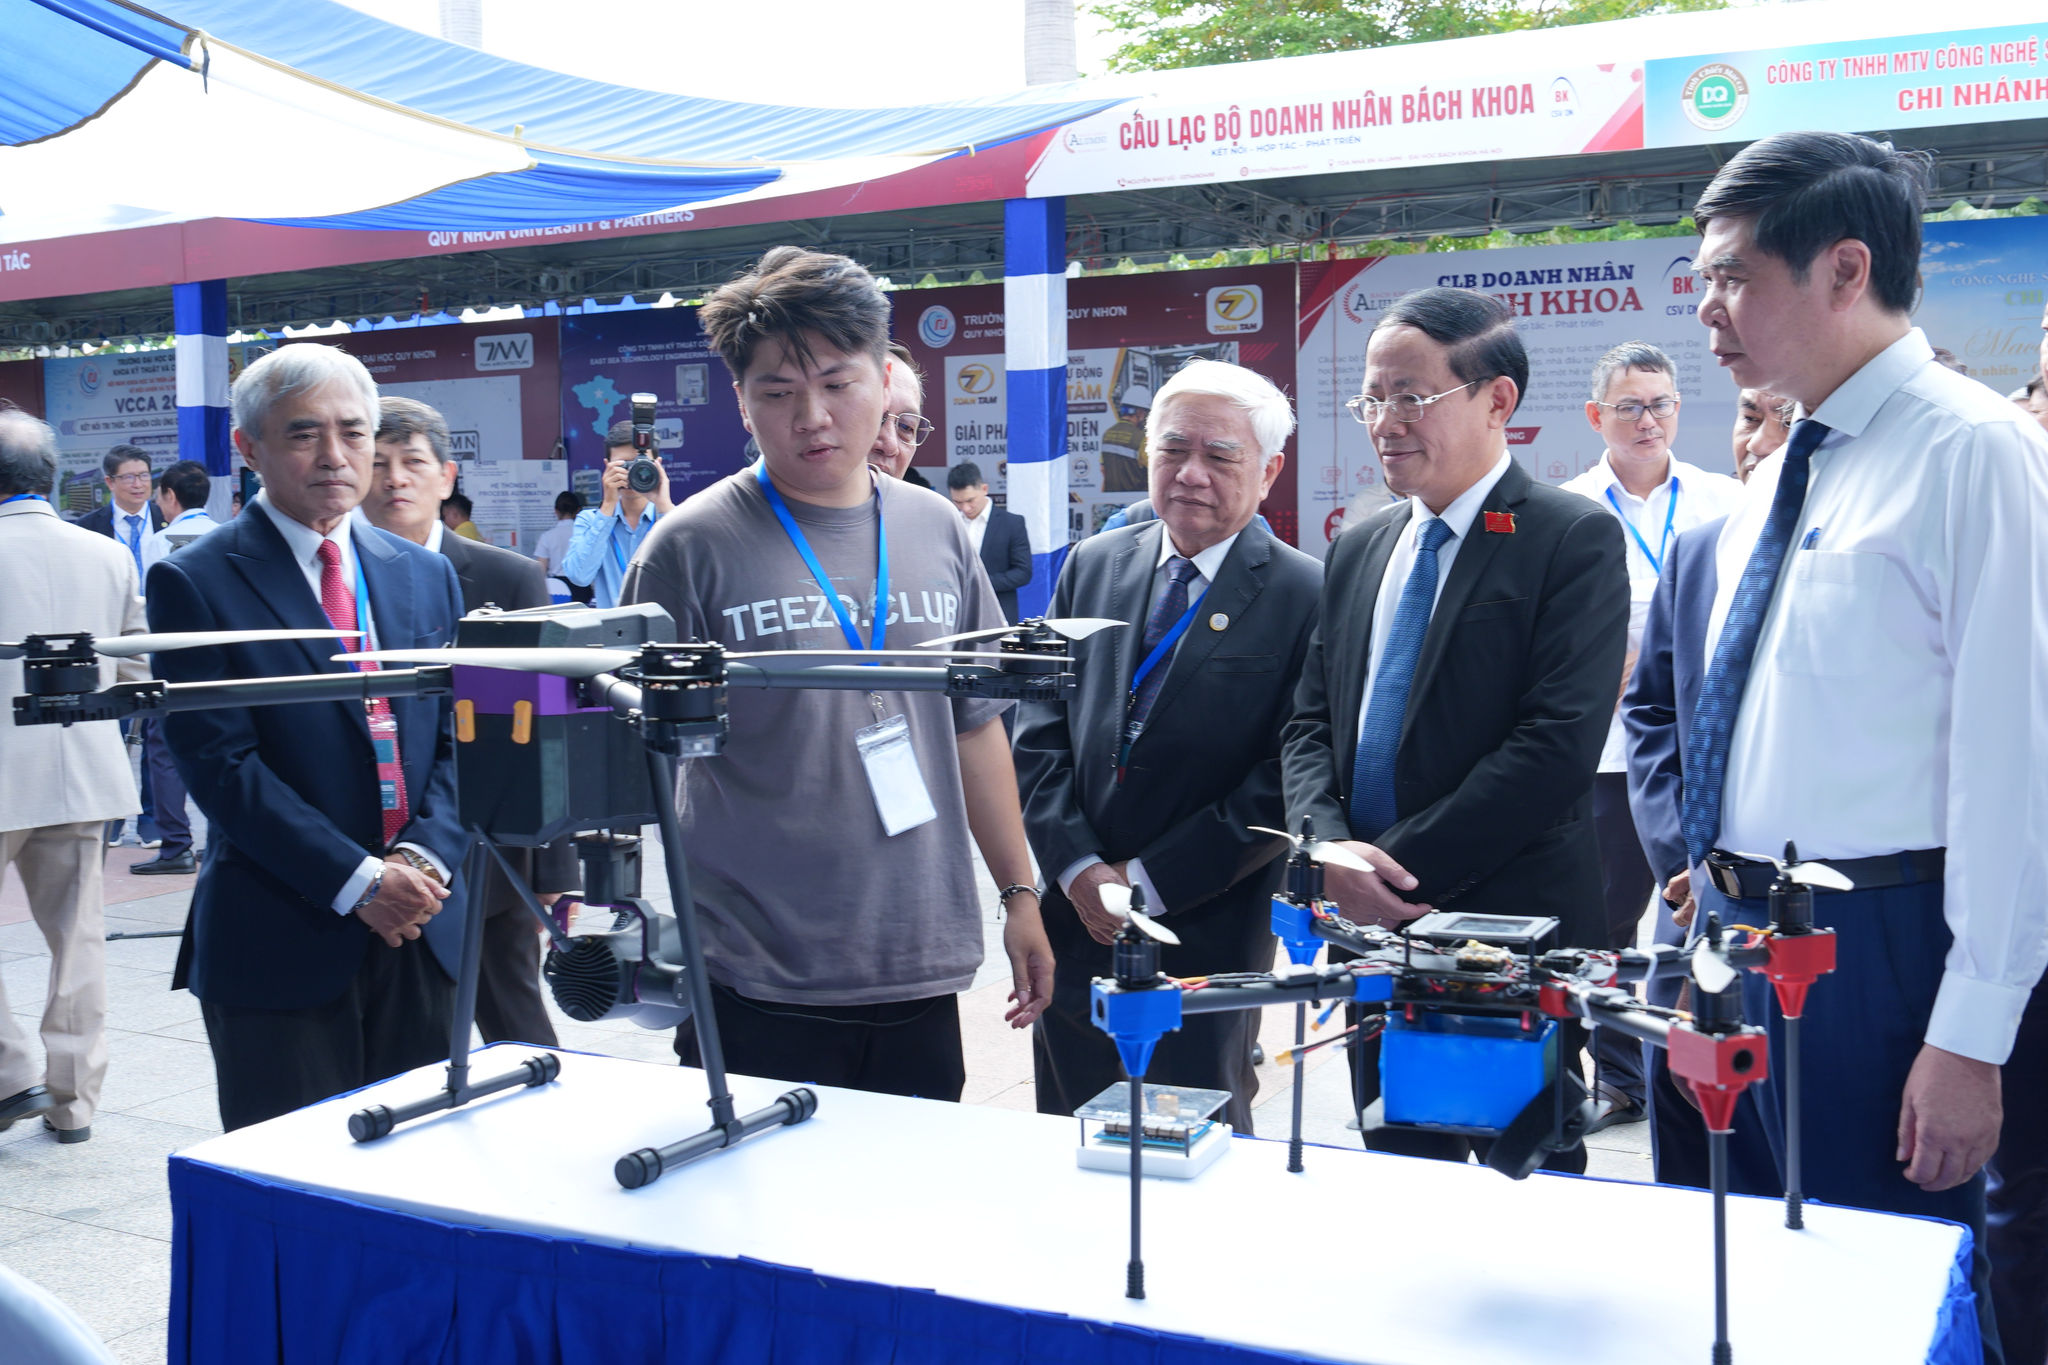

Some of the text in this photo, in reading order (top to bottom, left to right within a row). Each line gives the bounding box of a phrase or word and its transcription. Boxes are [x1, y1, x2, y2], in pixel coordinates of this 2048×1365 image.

[1767, 59, 1812, 84] CÔNG
[1818, 59, 1837, 80] TY
[1842, 55, 1887, 78] TNHH
[1893, 50, 1929, 73] MTV
[1936, 43, 1983, 69] CÔNG
[1990, 36, 2037, 66] NGHỆ
[1555, 90, 1568, 103] BK
[1898, 76, 2048, 111] CHI NHÁNH
[1168, 114, 1206, 151] LẠC
[1214, 104, 1241, 146] BỘ
[1250, 103, 1323, 138] DOANH
[1332, 89, 1392, 131] NHÂN
[1401, 85, 1462, 123] BÁCH
[1472, 83, 1535, 118] KHOA
[428, 231, 460, 247] QUY
[614, 210, 695, 229] PARTNERS
[3, 249, 31, 271] TÁC
[1437, 261, 1635, 289] CLB DOANH NHÂN
[1540, 287, 1644, 316] KHOA
[1665, 304, 1684, 316] CSV
[963, 329, 983, 339] QUY
[1075, 366, 1103, 381] ĐỘNG
[115, 395, 158, 414] VCCA
[955, 419, 982, 441] GIẢI
[1067, 416, 1099, 440] DIỆN
[955, 444, 976, 456] CHO
[1082, 440, 1099, 454] ĐẠI
